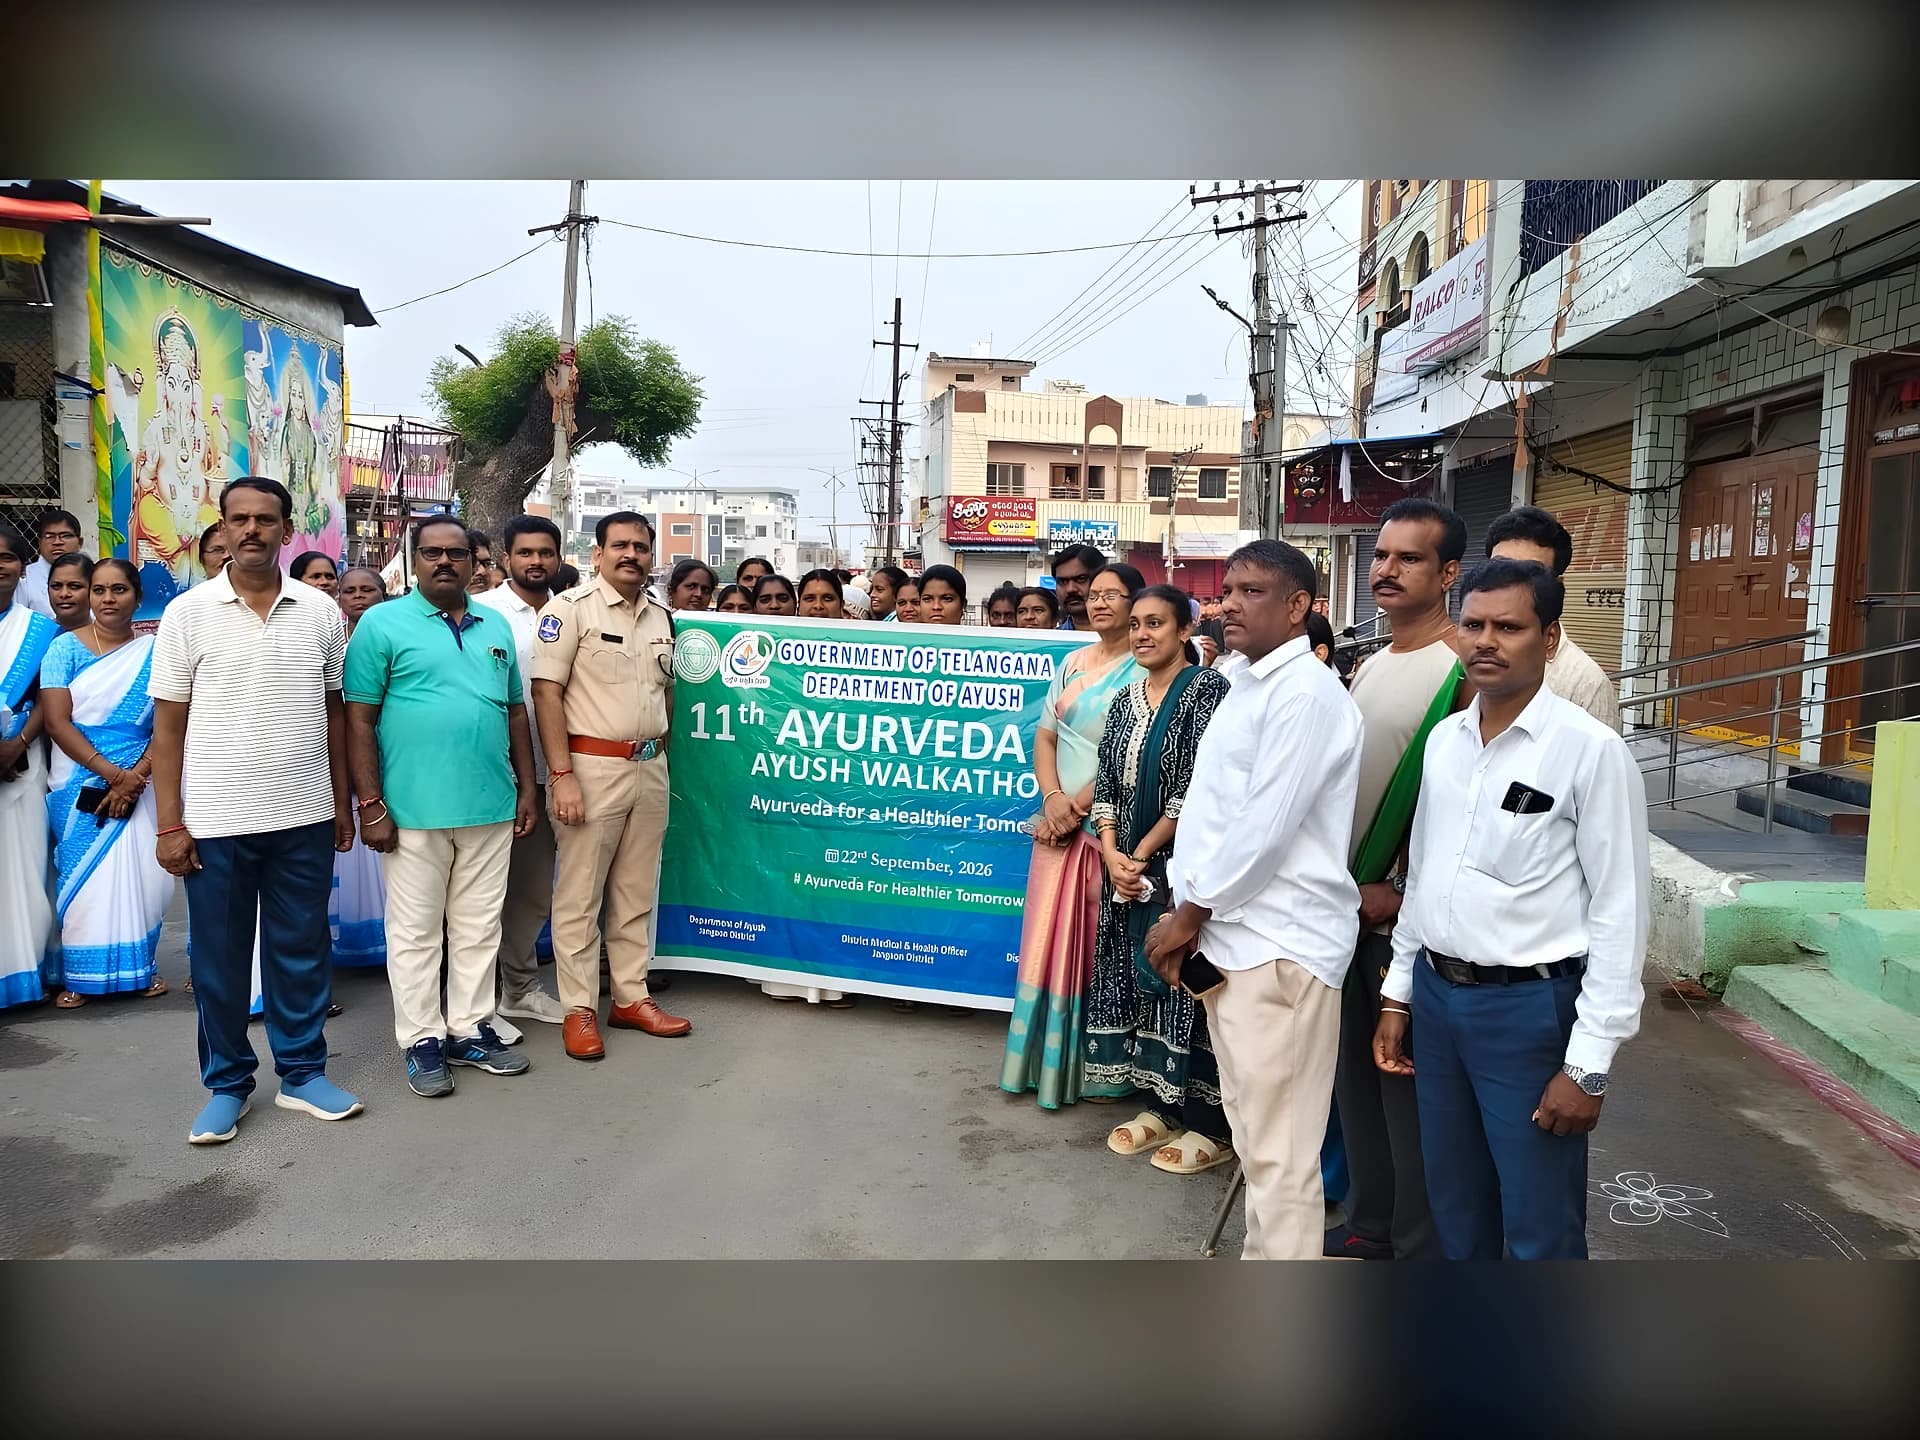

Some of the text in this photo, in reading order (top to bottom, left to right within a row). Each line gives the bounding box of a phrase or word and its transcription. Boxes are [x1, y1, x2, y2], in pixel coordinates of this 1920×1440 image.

[1413, 278, 1455, 326] RALCO
[781, 642, 1052, 677] GOVERNMENT OF TELANGANA
[807, 675, 1021, 708] DEPARTMENT OF AYUSH
[690, 701, 1027, 764] 11th AYURVEDA
[751, 752, 1040, 799] AYUSH WALKATHO
[750, 794, 1024, 834] Ayurveda for a Healthier Tomo
[871, 853, 954, 876] September,
[958, 860, 993, 877] 2026
[804, 873, 864, 892] Ayurveda
[868, 880, 888, 894] For
[891, 882, 953, 900] Healthier
[956, 888, 1025, 907] Tomorrow
[1006, 952, 1020, 964] Dis
